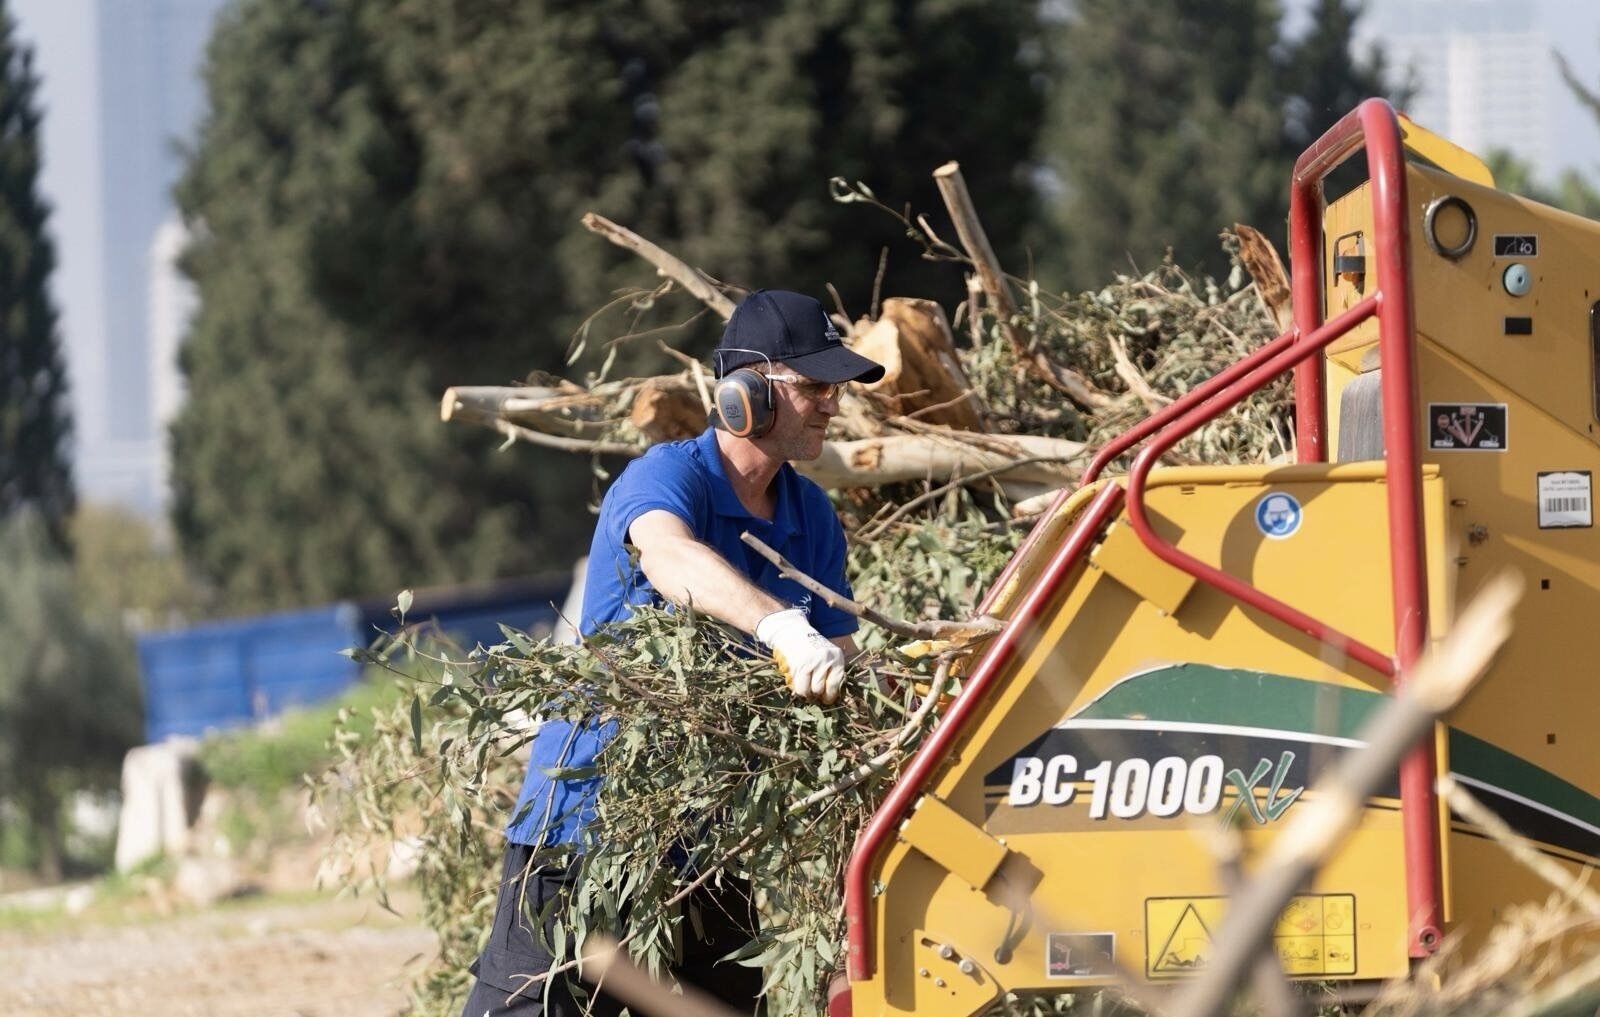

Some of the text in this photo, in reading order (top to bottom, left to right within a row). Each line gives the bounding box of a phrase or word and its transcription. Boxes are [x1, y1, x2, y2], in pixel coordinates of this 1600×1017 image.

[1008, 750, 1305, 832] BC 1000 XL
